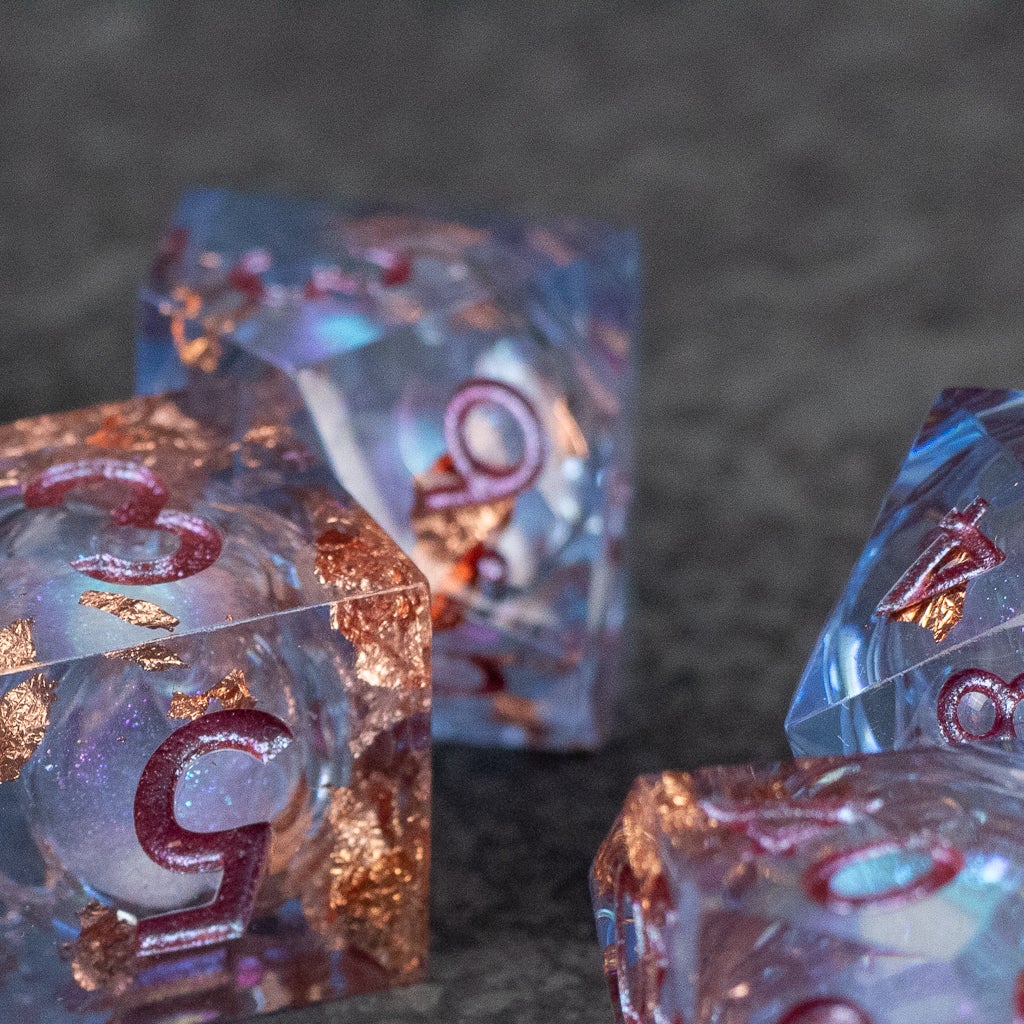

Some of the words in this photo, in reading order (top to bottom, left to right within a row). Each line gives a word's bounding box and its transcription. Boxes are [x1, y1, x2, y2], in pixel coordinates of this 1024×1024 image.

[23, 457, 223, 586] 3
[875, 495, 1007, 617] 4
[133, 708, 294, 958] 5
